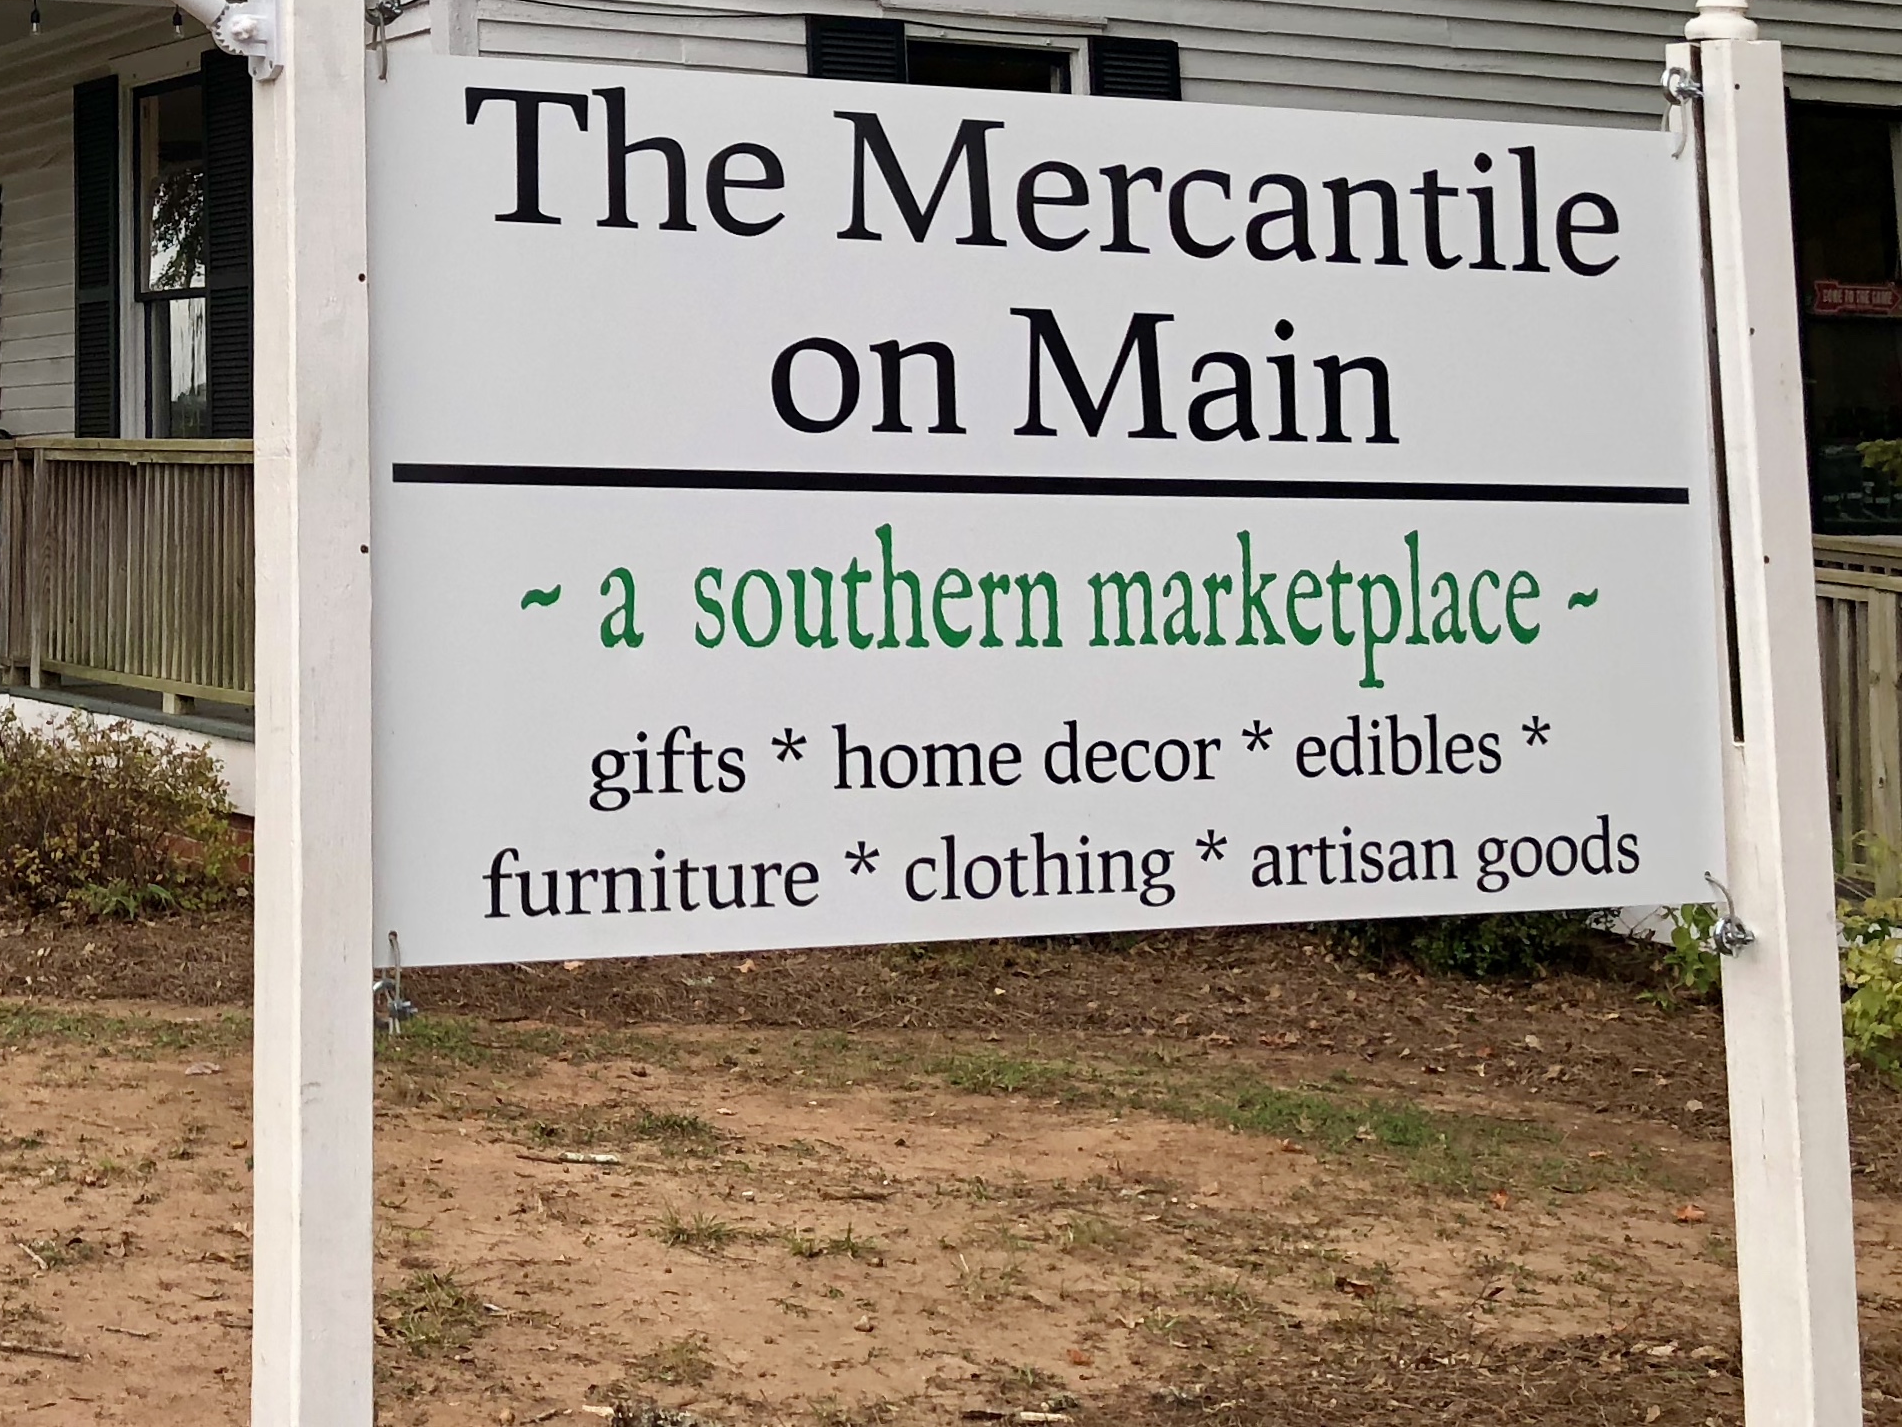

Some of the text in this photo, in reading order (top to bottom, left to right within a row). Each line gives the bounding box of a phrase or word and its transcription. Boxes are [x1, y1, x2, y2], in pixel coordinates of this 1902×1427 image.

[465, 86, 1620, 277] The Mercantile
[771, 307, 1400, 445] on Main
[600, 566, 645, 649] a
[694, 523, 1063, 650] southern
[1087, 529, 1541, 689] marketplace
[589, 713, 1502, 812] gifts home decor edibles
[482, 814, 1640, 919] furniture clothing artisan goods
